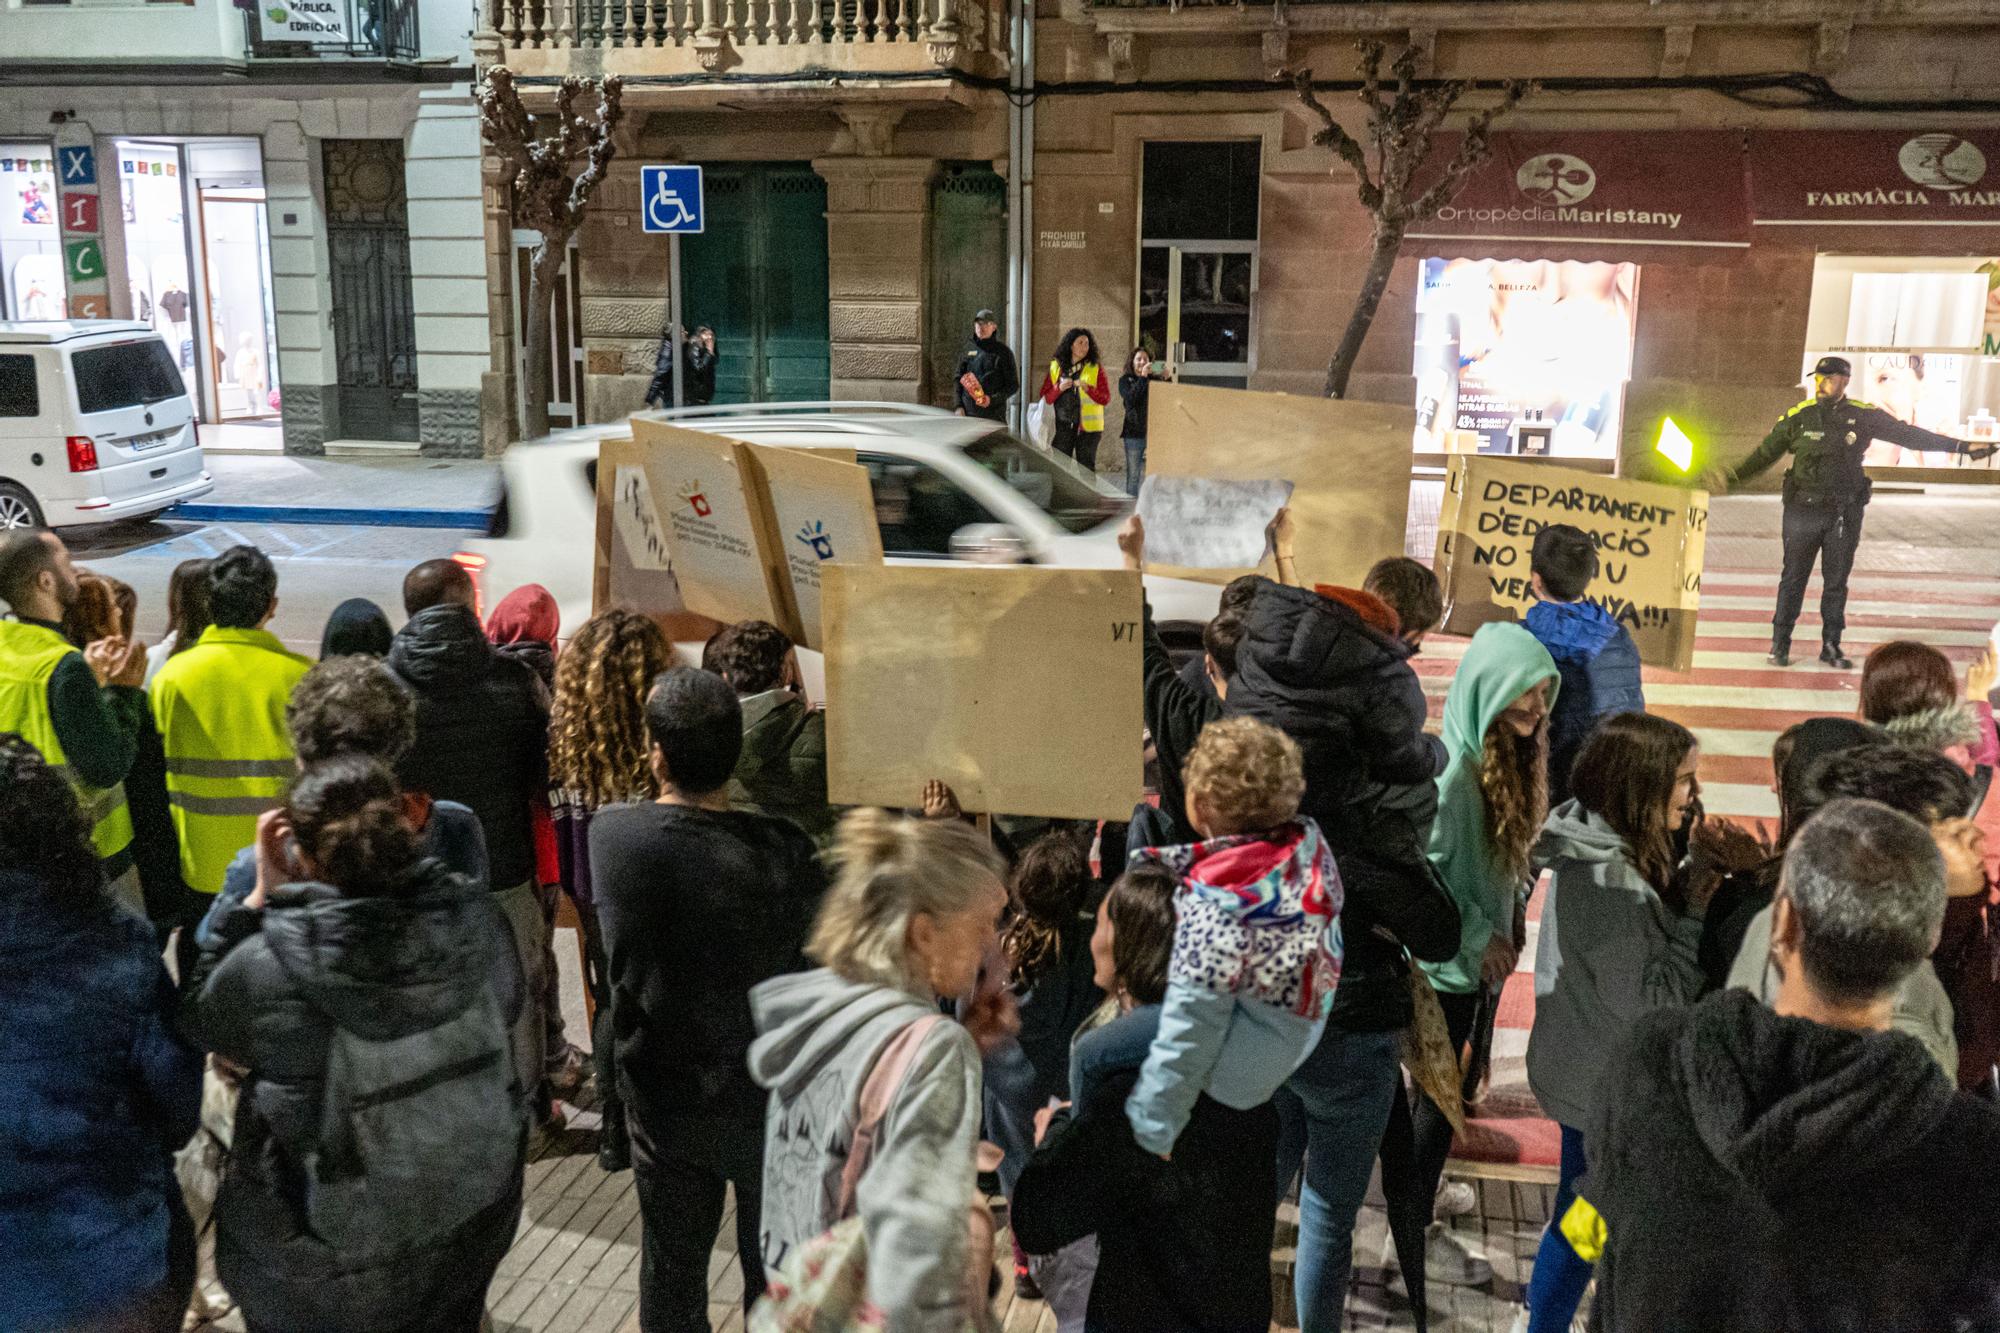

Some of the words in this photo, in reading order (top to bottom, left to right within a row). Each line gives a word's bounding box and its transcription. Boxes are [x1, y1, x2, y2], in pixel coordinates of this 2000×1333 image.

[1806, 187, 1930, 206] FARMÀCIA
[1040, 231, 1086, 240] PROHIBIT
[1483, 480, 1676, 526] DEPARTAMENT
[1478, 507, 1652, 557] D'EDACIÓ
[1474, 545, 1518, 566] NO
